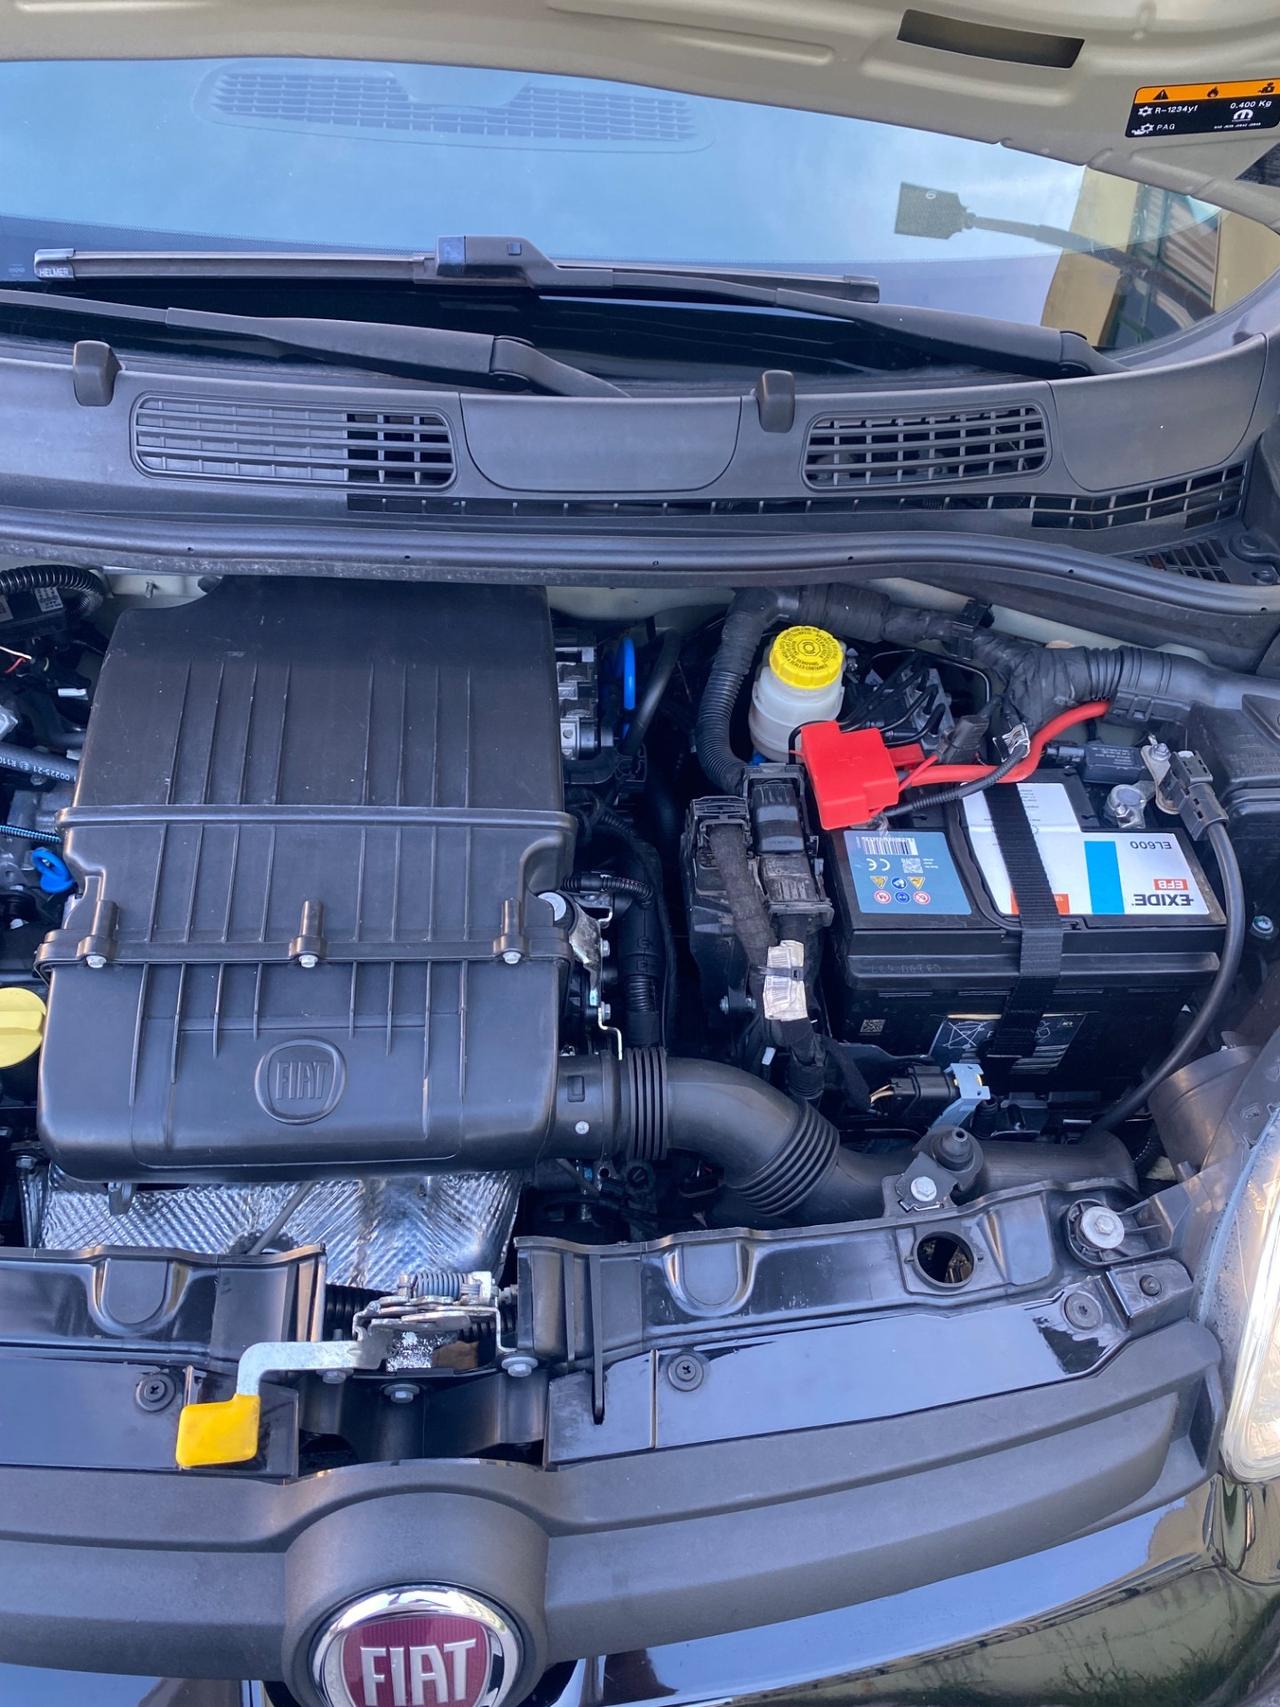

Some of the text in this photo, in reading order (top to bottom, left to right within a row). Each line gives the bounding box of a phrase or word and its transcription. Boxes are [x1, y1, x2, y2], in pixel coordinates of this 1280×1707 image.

[1230, 100, 1272, 109] 0.400 Kg
[1155, 105, 1199, 114] R-1234yf
[1156, 123, 1176, 131] PAG
[1130, 841, 1172, 850] EL600
[1158, 880, 1184, 890] EFB
[1133, 893, 1194, 906] EXIDE
[276, 1061, 330, 1100] FIAT
[360, 1638, 477, 1707] FIAT
